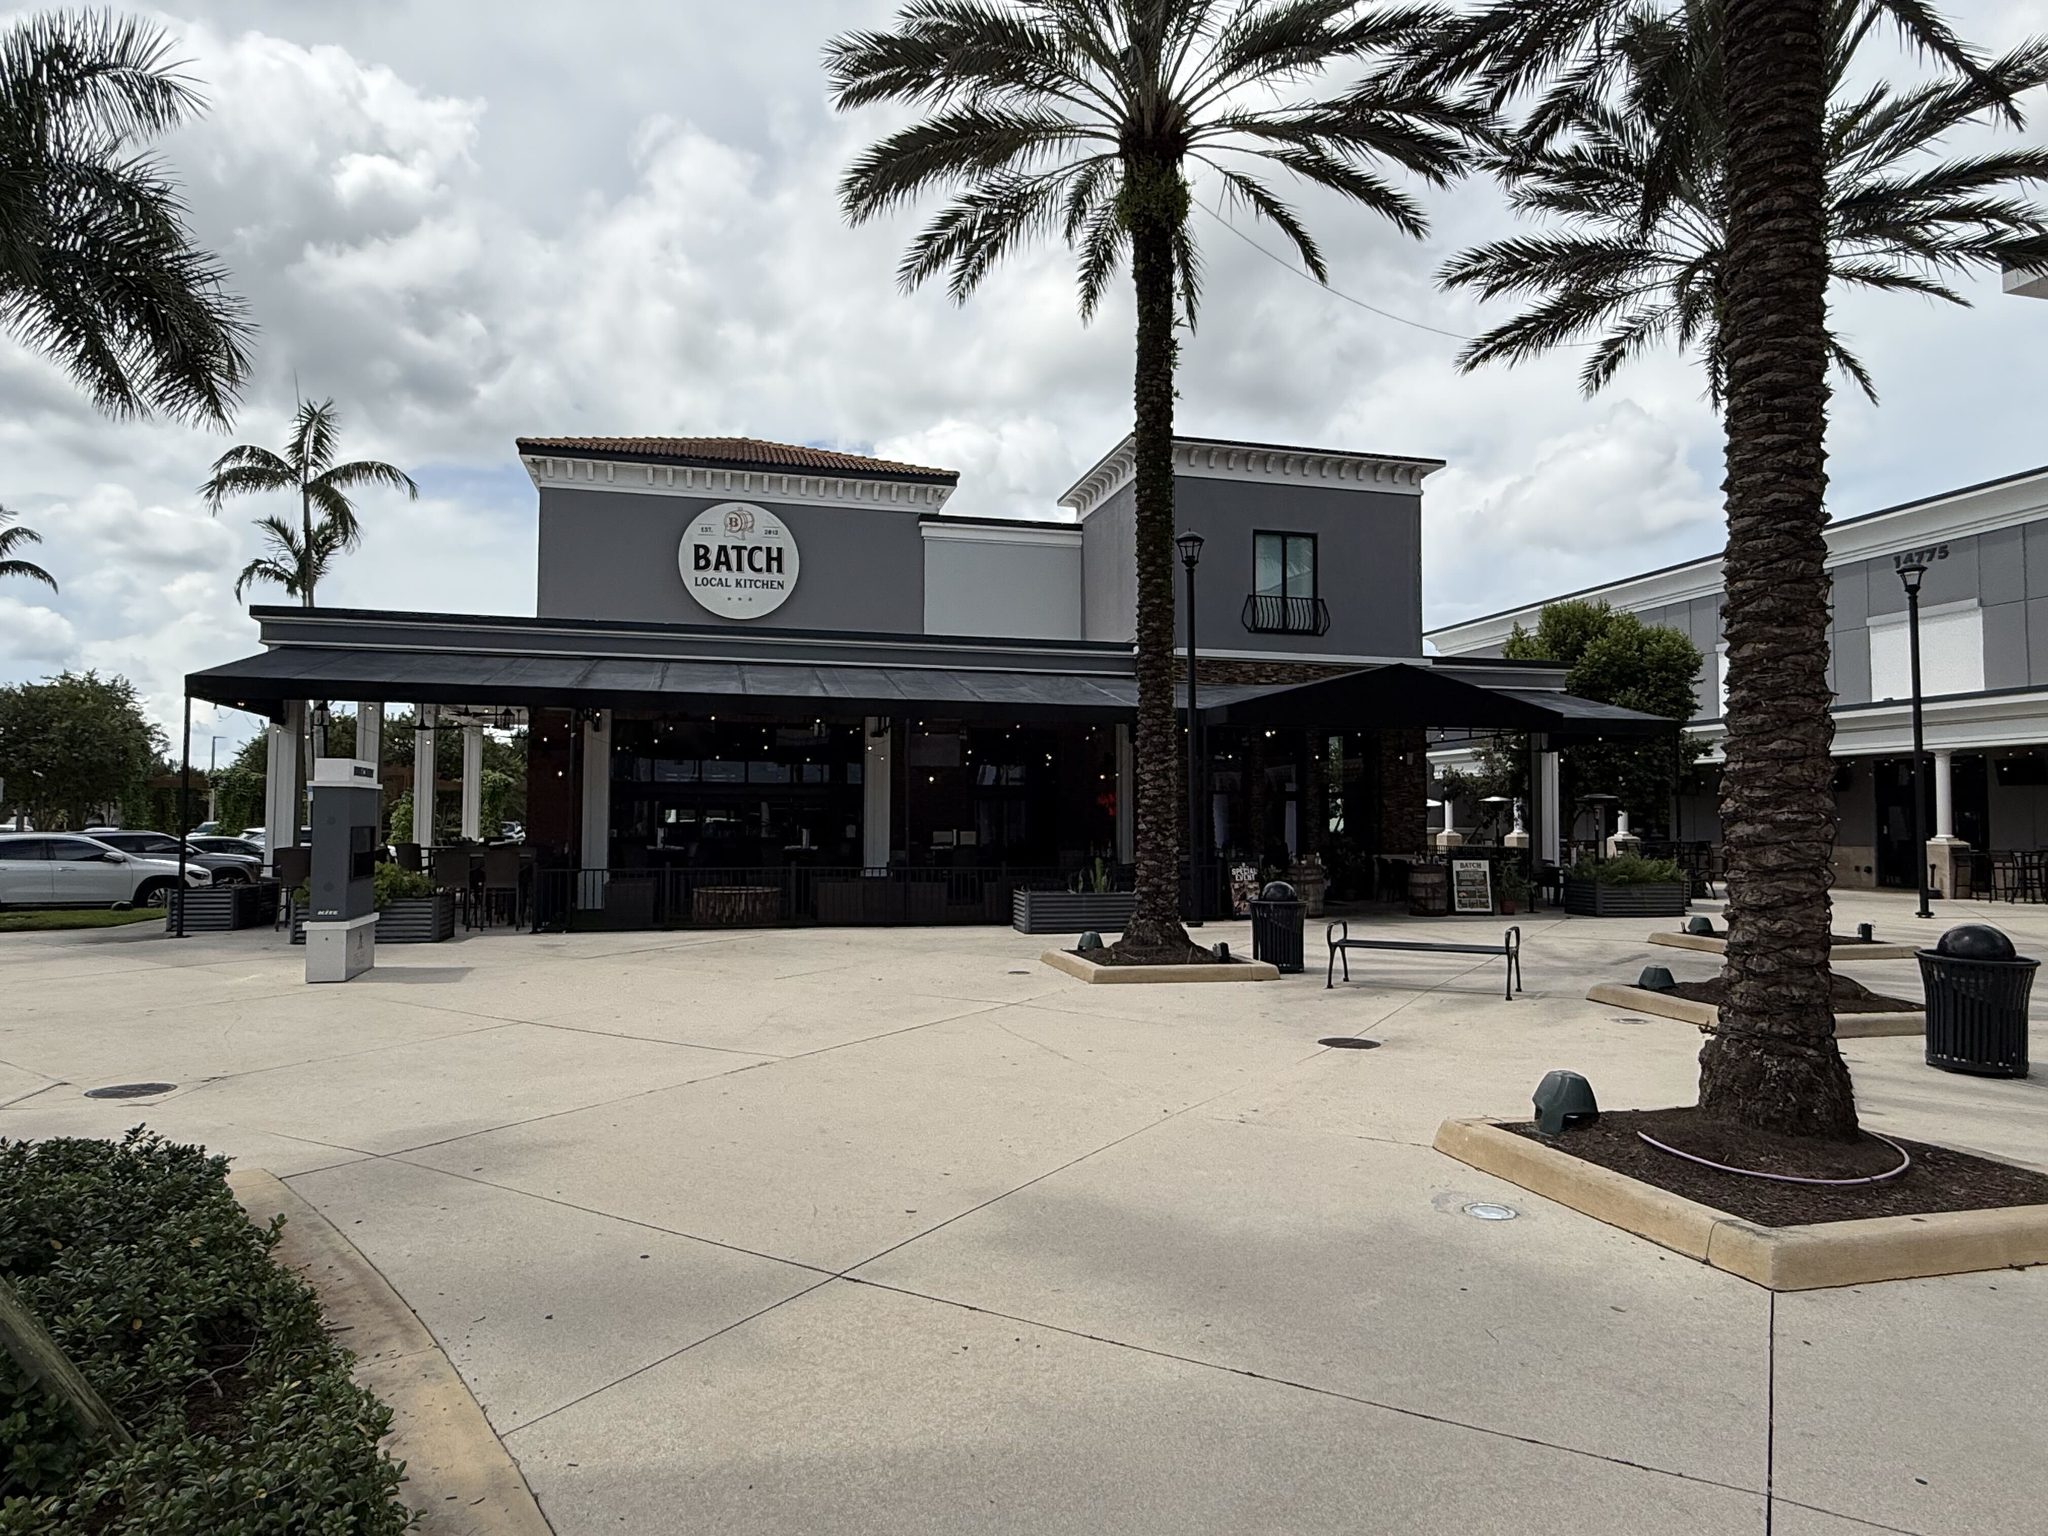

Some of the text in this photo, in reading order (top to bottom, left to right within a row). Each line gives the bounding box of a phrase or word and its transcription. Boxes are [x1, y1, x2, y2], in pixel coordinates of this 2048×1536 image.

[693, 544, 785, 574] BATCH
[1894, 544, 1949, 569] 14775
[694, 577, 785, 590] LOCAL KITCHEN
